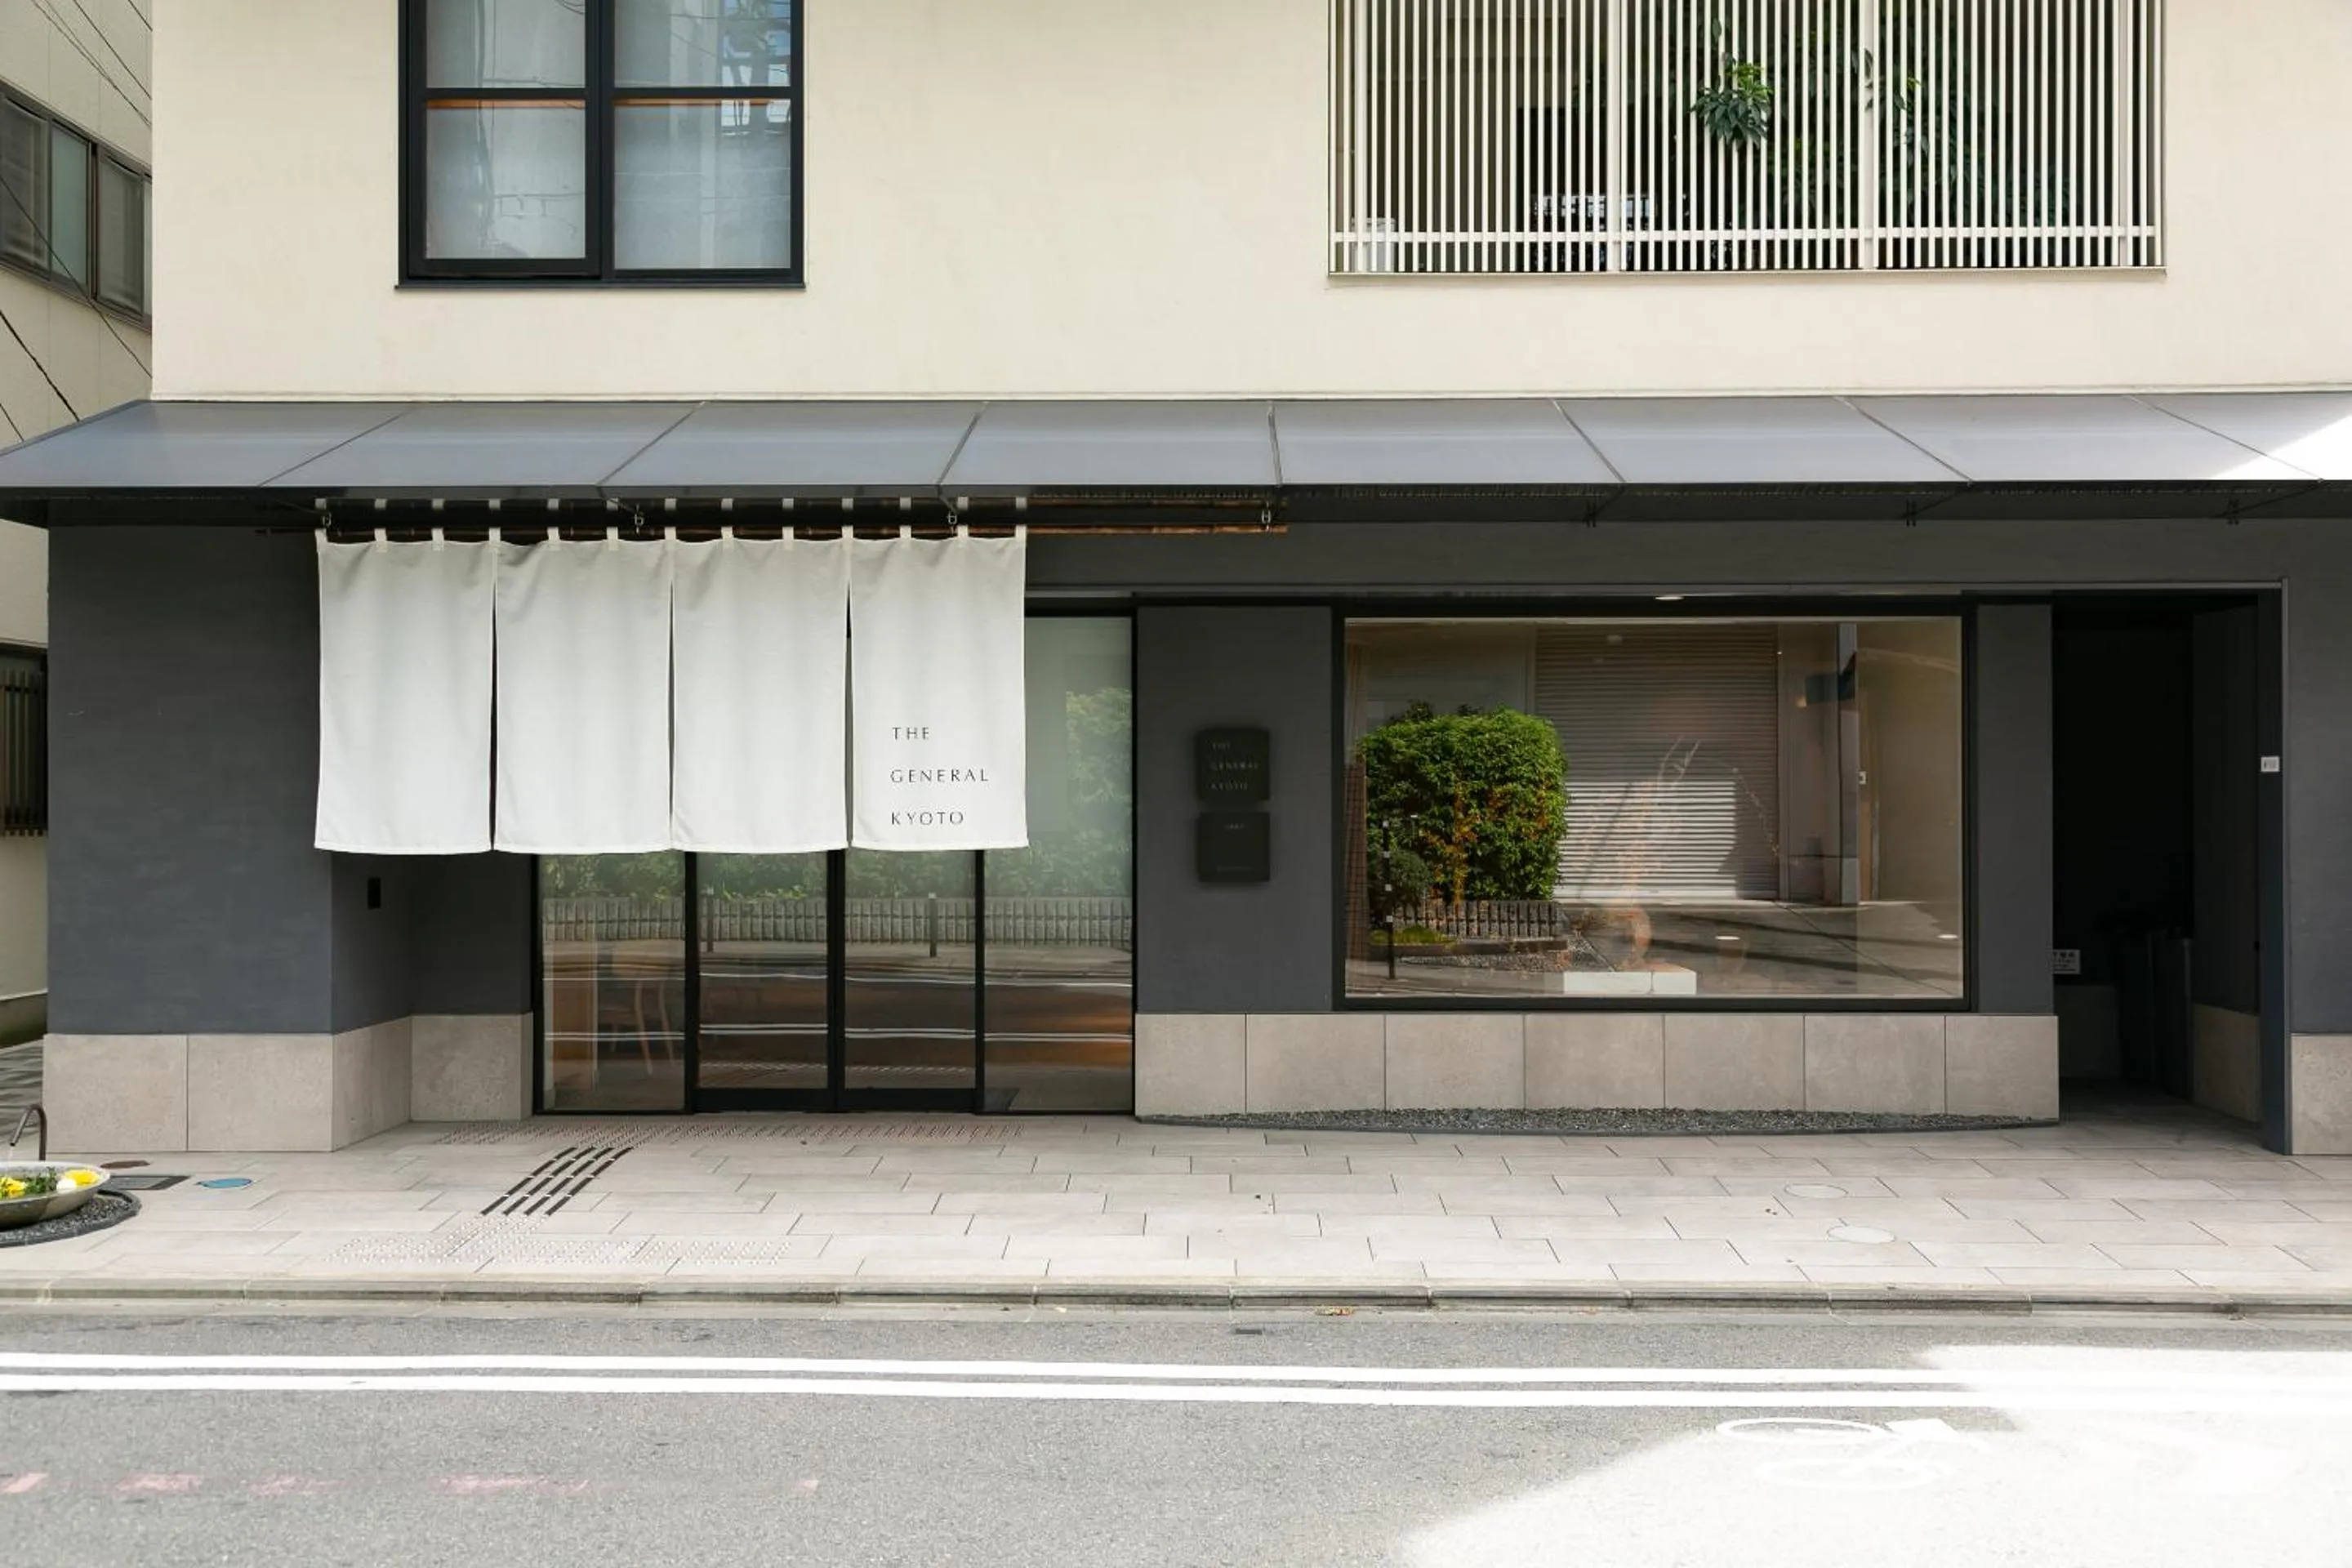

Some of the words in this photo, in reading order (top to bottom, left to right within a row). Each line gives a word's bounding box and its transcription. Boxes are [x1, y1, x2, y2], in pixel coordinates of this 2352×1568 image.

[892, 726, 929, 740] THE
[890, 768, 989, 783] GENERAL
[891, 811, 964, 826] KYOTO
